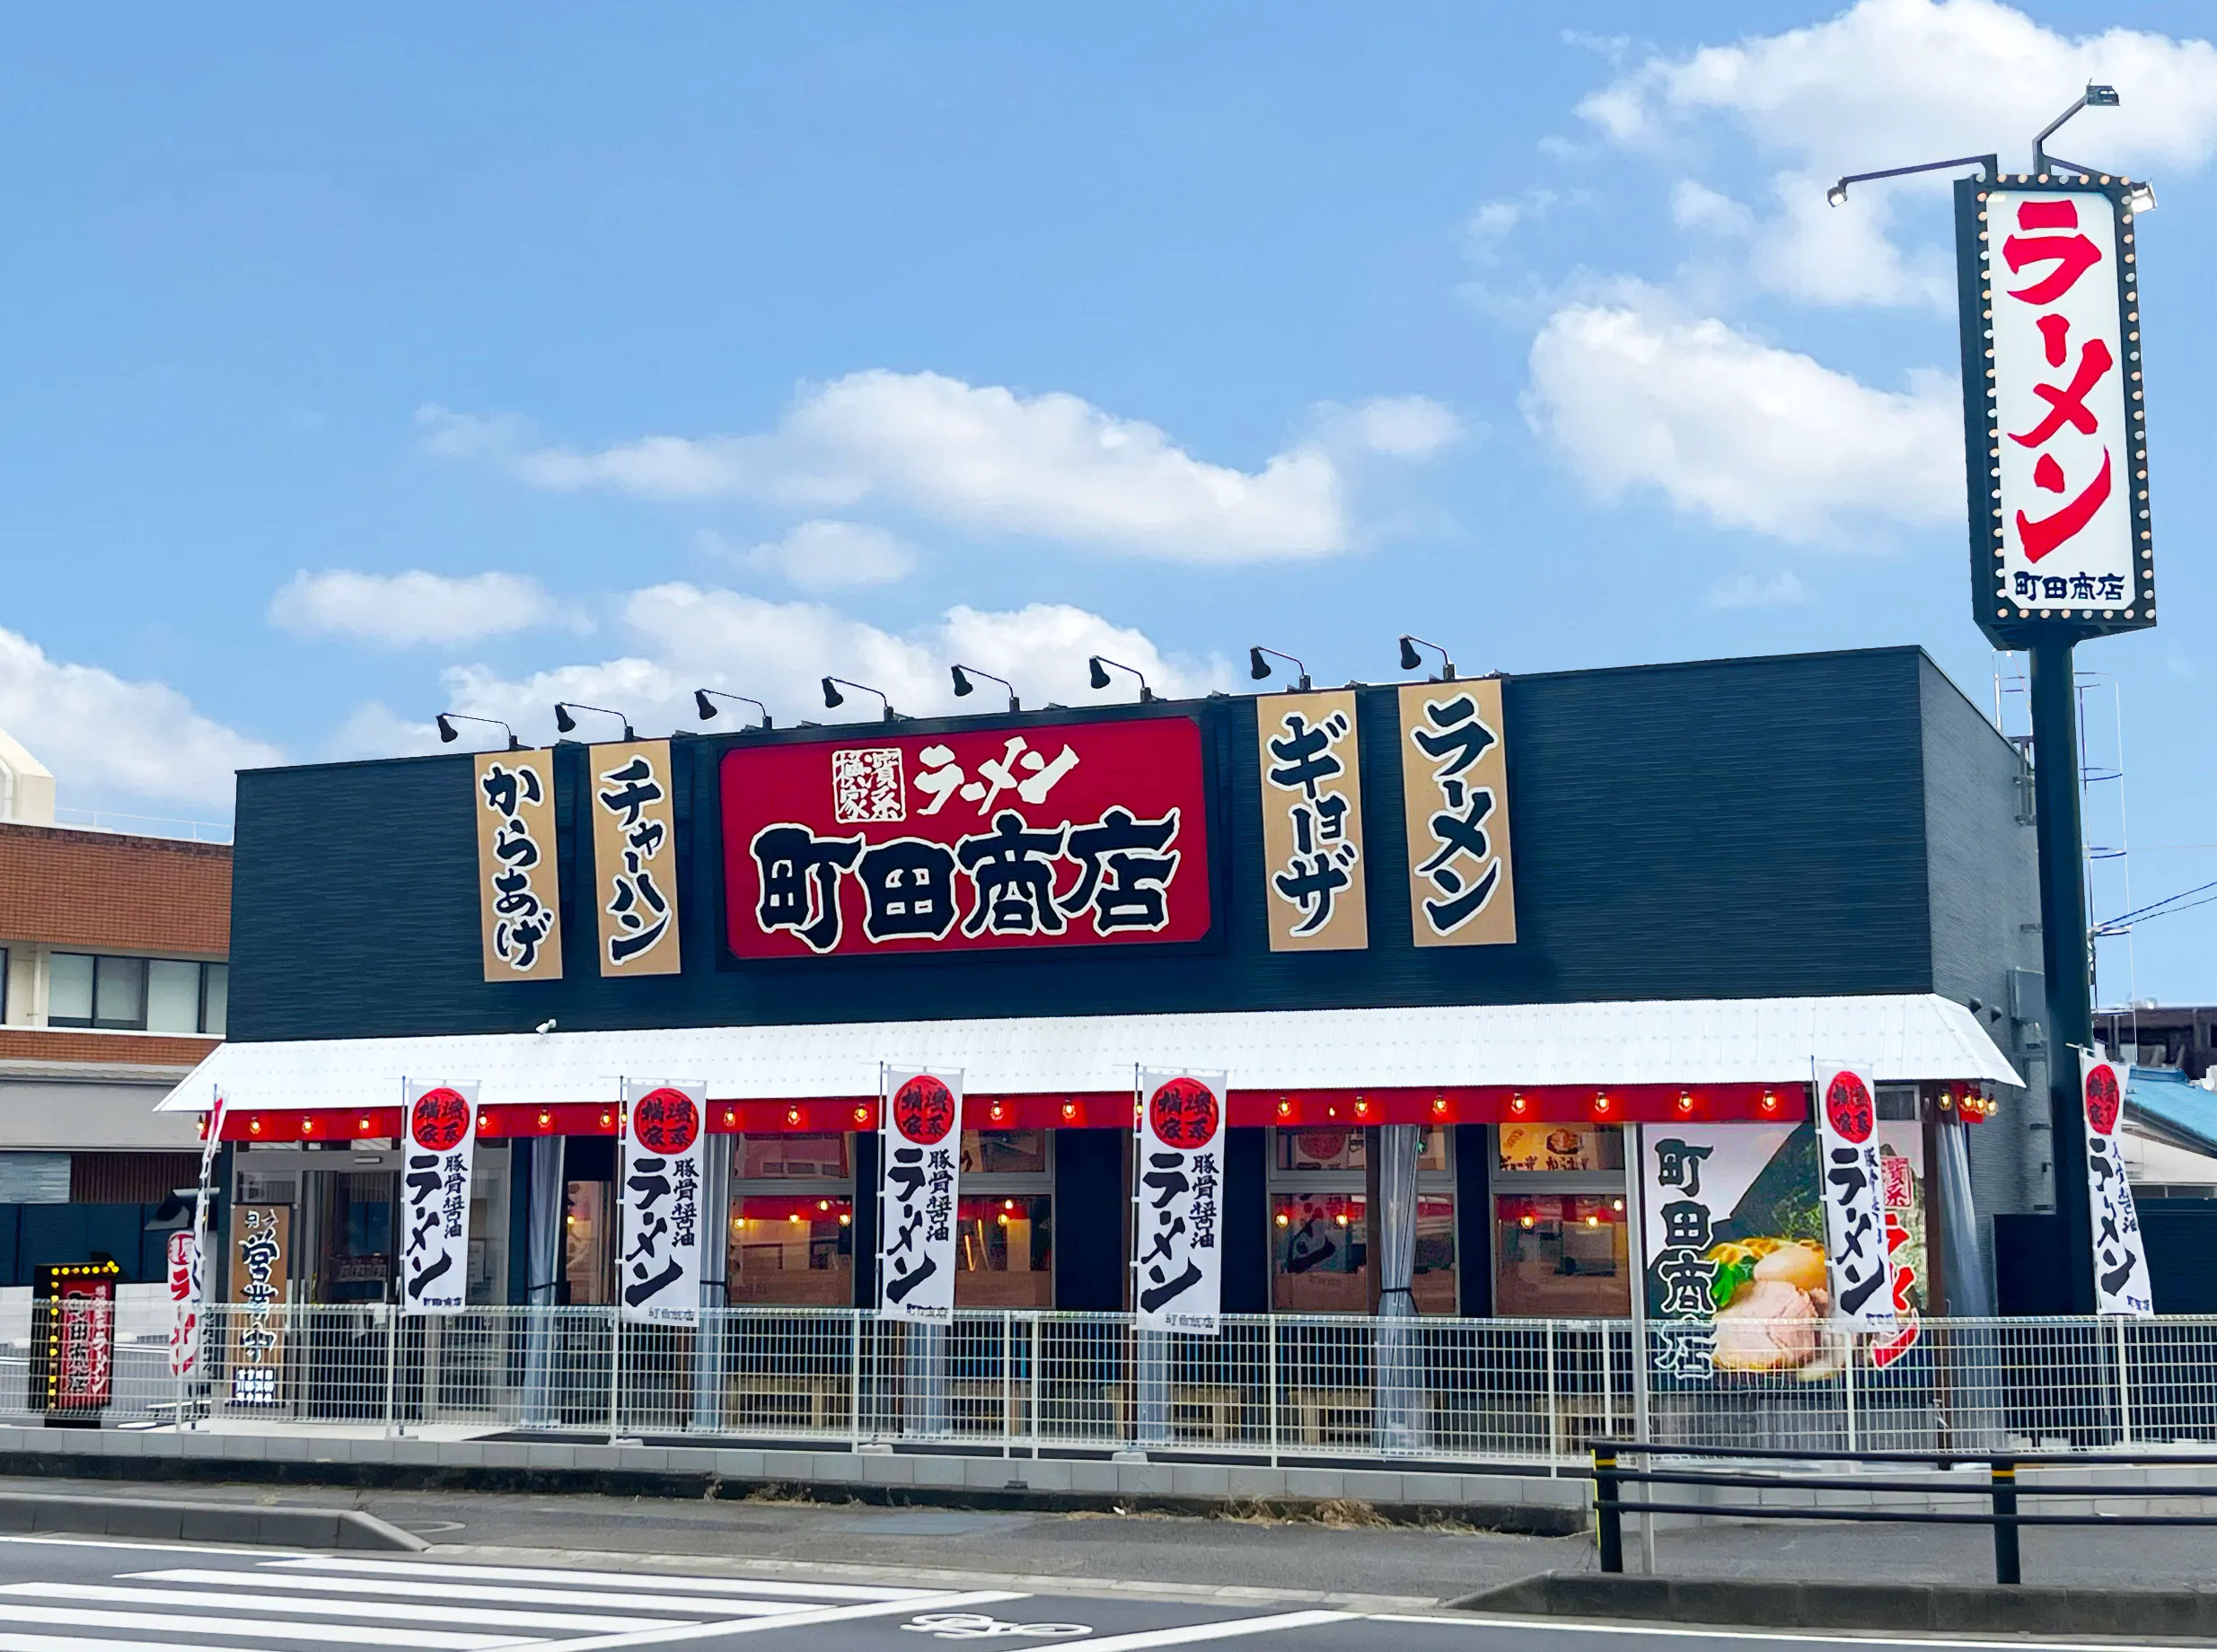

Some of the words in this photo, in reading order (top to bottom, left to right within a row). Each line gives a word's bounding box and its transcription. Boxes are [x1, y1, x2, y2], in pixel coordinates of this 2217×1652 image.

[2002, 199, 2113, 563] ラーメン
[2013, 571, 2125, 601] 町田商店
[913, 736, 1079, 815] ラーメン
[1267, 709, 1359, 936] ギョーザ
[1410, 692, 1499, 936] ラーメン
[479, 762, 554, 971] からあげ
[597, 754, 673, 966] チャーハン
[750, 805, 1180, 953] 町田商店
[406, 1155, 452, 1300] ラーメン
[625, 1158, 683, 1307] ラーメン
[886, 1148, 937, 1305] ラーメン
[1140, 1153, 1202, 1314] ラーメン
[1655, 1138, 1719, 1379] 町田商店
[1827, 1147, 1885, 1315] ラーメン
